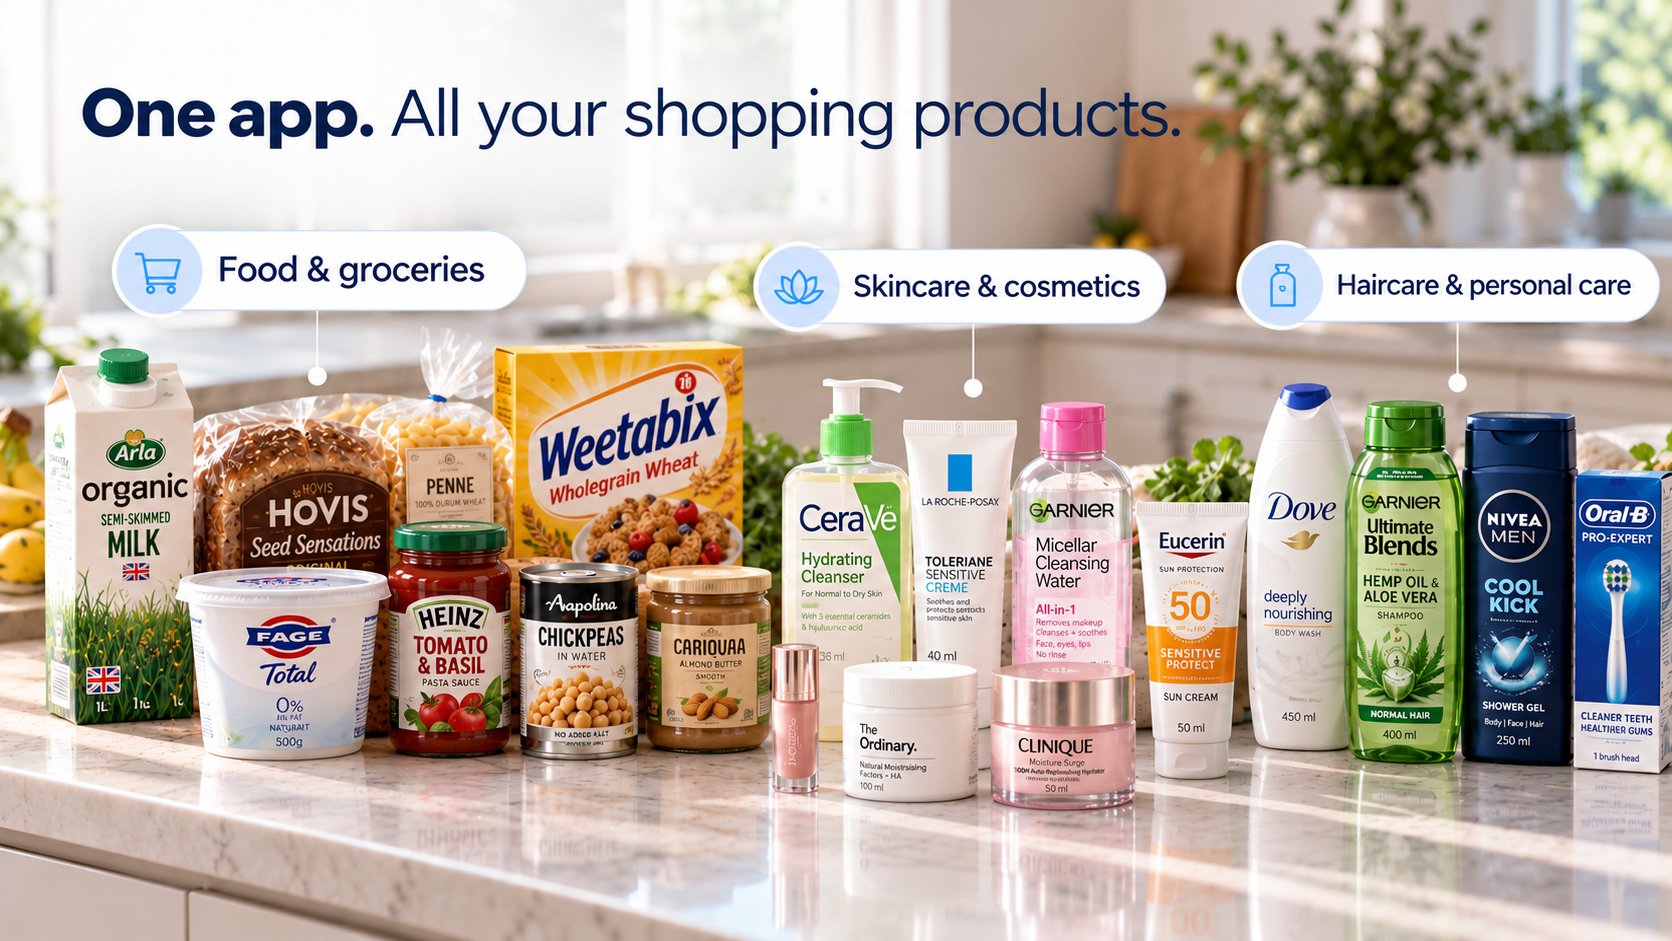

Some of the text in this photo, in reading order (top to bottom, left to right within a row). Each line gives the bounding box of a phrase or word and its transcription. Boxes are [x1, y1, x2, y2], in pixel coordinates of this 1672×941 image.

[539, 393, 721, 481] Weetabix
[114, 444, 156, 462] Arla
[549, 451, 700, 505] Wholegrain Wheat
[82, 472, 188, 508] organic
[426, 477, 475, 495] PENNE
[922, 498, 933, 506] LA
[1267, 491, 1337, 521] Dove
[269, 494, 369, 528] HOVIS
[1585, 504, 1648, 524] Oral-B
[101, 511, 171, 526] SEMI-SKIMMED
[1487, 512, 1542, 527] NIVEA
[1367, 518, 1434, 534] Ultimate
[108, 528, 160, 558] MILK
[1159, 532, 1224, 549] Eucerin
[1491, 529, 1535, 544] MEN
[1582, 532, 1653, 544] PRO-EXPERT
[250, 531, 381, 559] Seed Sensations
[1036, 537, 1097, 553] Micellar
[1364, 535, 1438, 556] Blends
[801, 552, 872, 569] Hydrating
[925, 556, 993, 567] TOLERIANE
[1035, 555, 1110, 573] Cleansing
[801, 569, 864, 584] Cleanser
[925, 569, 986, 580] SENSITIVE
[1035, 573, 1081, 588] Water
[926, 582, 968, 593] CREME
[1363, 575, 1439, 588] HEMP OIL &
[1484, 578, 1543, 595] COOL
[801, 590, 883, 599] For Normal to Dry Skin
[1264, 589, 1307, 606] deeply
[1363, 590, 1438, 603] ALOE VERA
[1036, 604, 1076, 615] All-in-1
[1489, 597, 1539, 614] KICK
[418, 606, 484, 630] HEINZ
[1264, 606, 1333, 623] nourishing
[1377, 611, 1424, 620] SHAMPOO
[256, 631, 323, 643] FAGE
[538, 626, 624, 648] CHICKPEAS
[1274, 629, 1321, 638] BODY WASH
[413, 636, 488, 655] TOMATO
[557, 651, 606, 661] IN WATER
[834, 652, 845, 661] ml
[927, 650, 957, 661] 40 ml
[1160, 647, 1221, 658] SENSITIVE
[418, 657, 485, 675] & BASIL
[714, 660, 743, 668] BUTTER
[1166, 659, 1215, 670] PROTECT
[259, 661, 318, 686] Total
[422, 678, 480, 687] PASTA SAUCE
[1163, 692, 1219, 702] SUN CREAM
[276, 697, 304, 713] 0%
[1482, 701, 1545, 712] SHOWER GEL
[1282, 712, 1316, 722] 450 ml
[1370, 710, 1431, 719] NORMAL HAIR
[1581, 711, 1653, 724] CLEANER TEETH
[860, 723, 877, 735] The
[1177, 723, 1205, 733] 50 ml
[1484, 718, 1502, 728] Body
[1382, 730, 1417, 740] 400 ml
[1628, 727, 1653, 736] GUMS
[276, 736, 303, 748] 500g
[859, 736, 917, 755] Ordinary.
[1018, 737, 1093, 756] CLINIQUE
[1496, 735, 1531, 746] 250 ml
[1029, 758, 1062, 766] Moisture
[1593, 752, 1640, 762] 1 brush head
[860, 782, 884, 791] 100 ml
[1045, 784, 1069, 793] 50 ml
